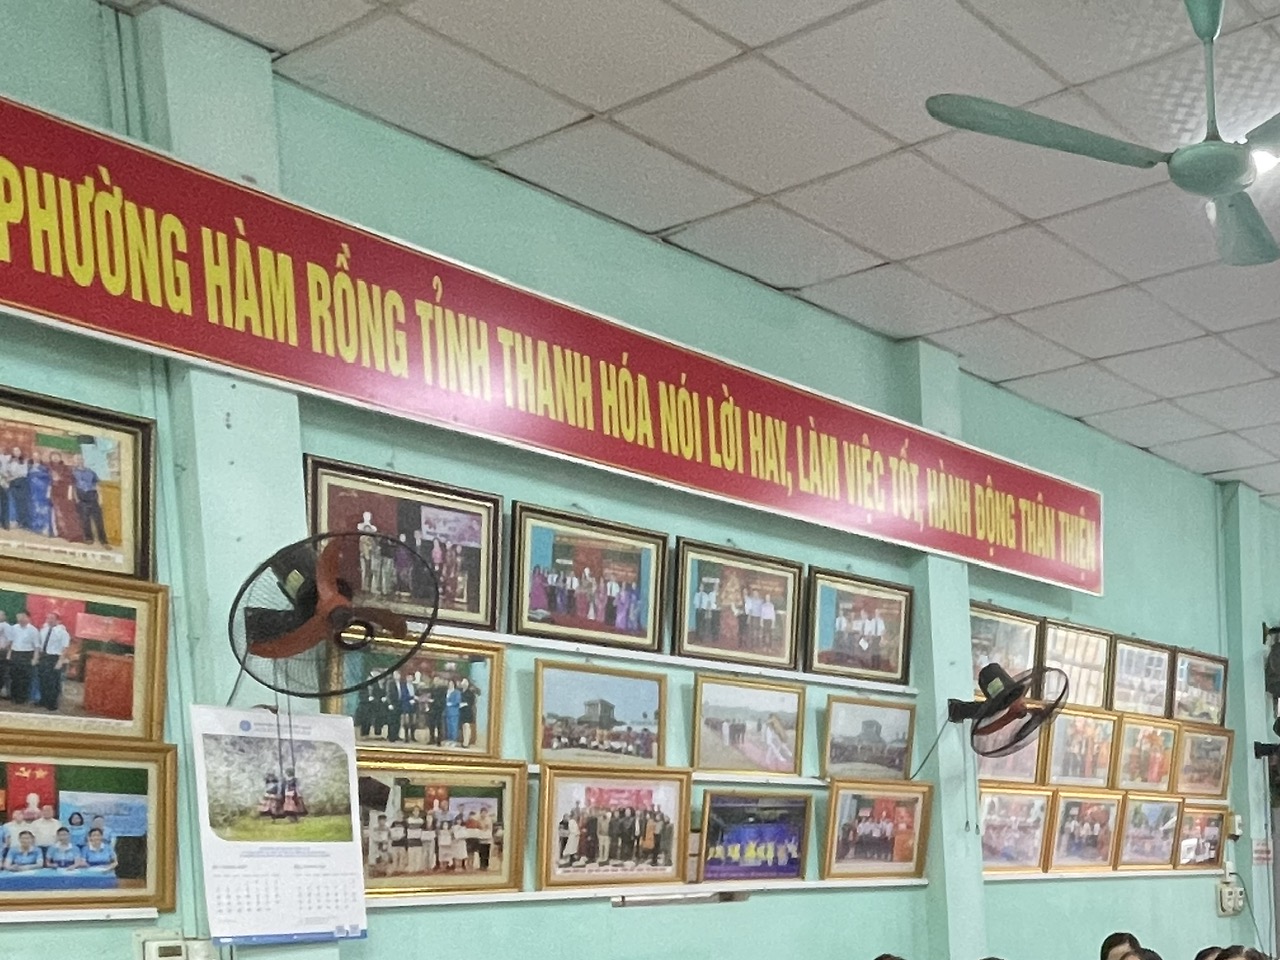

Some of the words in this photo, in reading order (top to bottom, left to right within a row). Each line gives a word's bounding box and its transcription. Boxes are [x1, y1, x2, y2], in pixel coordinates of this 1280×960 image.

[0, 155, 192, 317] PHƯỜNG
[201, 217, 299, 347] HÀM
[306, 243, 409, 379] RỒNG
[415, 275, 492, 400] TỈNH
[497, 326, 595, 432] THANH
[600, 351, 655, 449] HÓA
[658, 373, 703, 463] NÓI
[707, 383, 744, 474] LỜI
[747, 409, 793, 496] HAY,
[796, 415, 840, 502] LÀM
[842, 433, 886, 523] VIỆC
[888, 438, 925, 531] TỐT,
[926, 459, 973, 538] HÀNH
[974, 475, 1017, 556] ĐỘNG
[1018, 492, 1056, 560] THÂN
[1058, 506, 1097, 581] THIỆN
